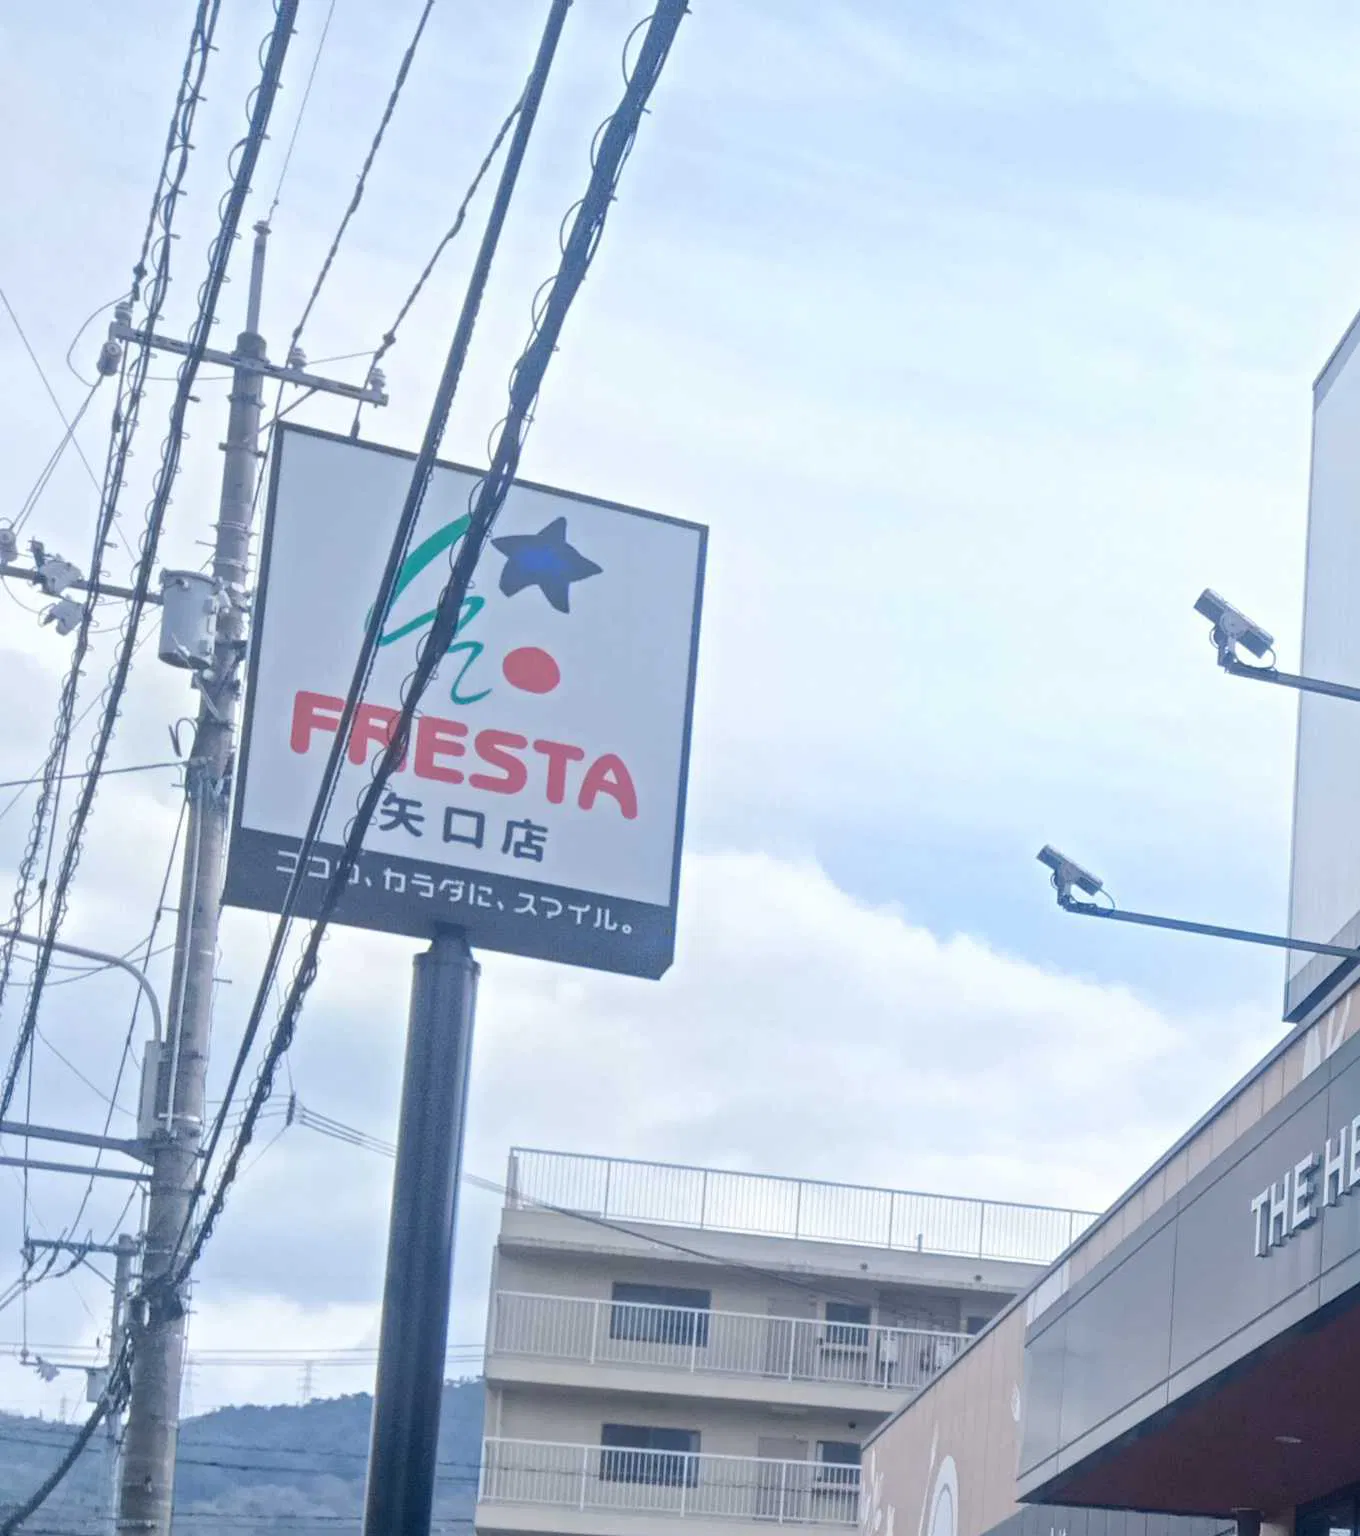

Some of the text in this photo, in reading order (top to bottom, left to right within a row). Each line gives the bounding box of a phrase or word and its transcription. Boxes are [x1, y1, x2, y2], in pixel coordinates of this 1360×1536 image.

[289, 690, 639, 820] FRESTA
[378, 793, 550, 863] 矢口店
[1249, 1154, 1319, 1258] THE
